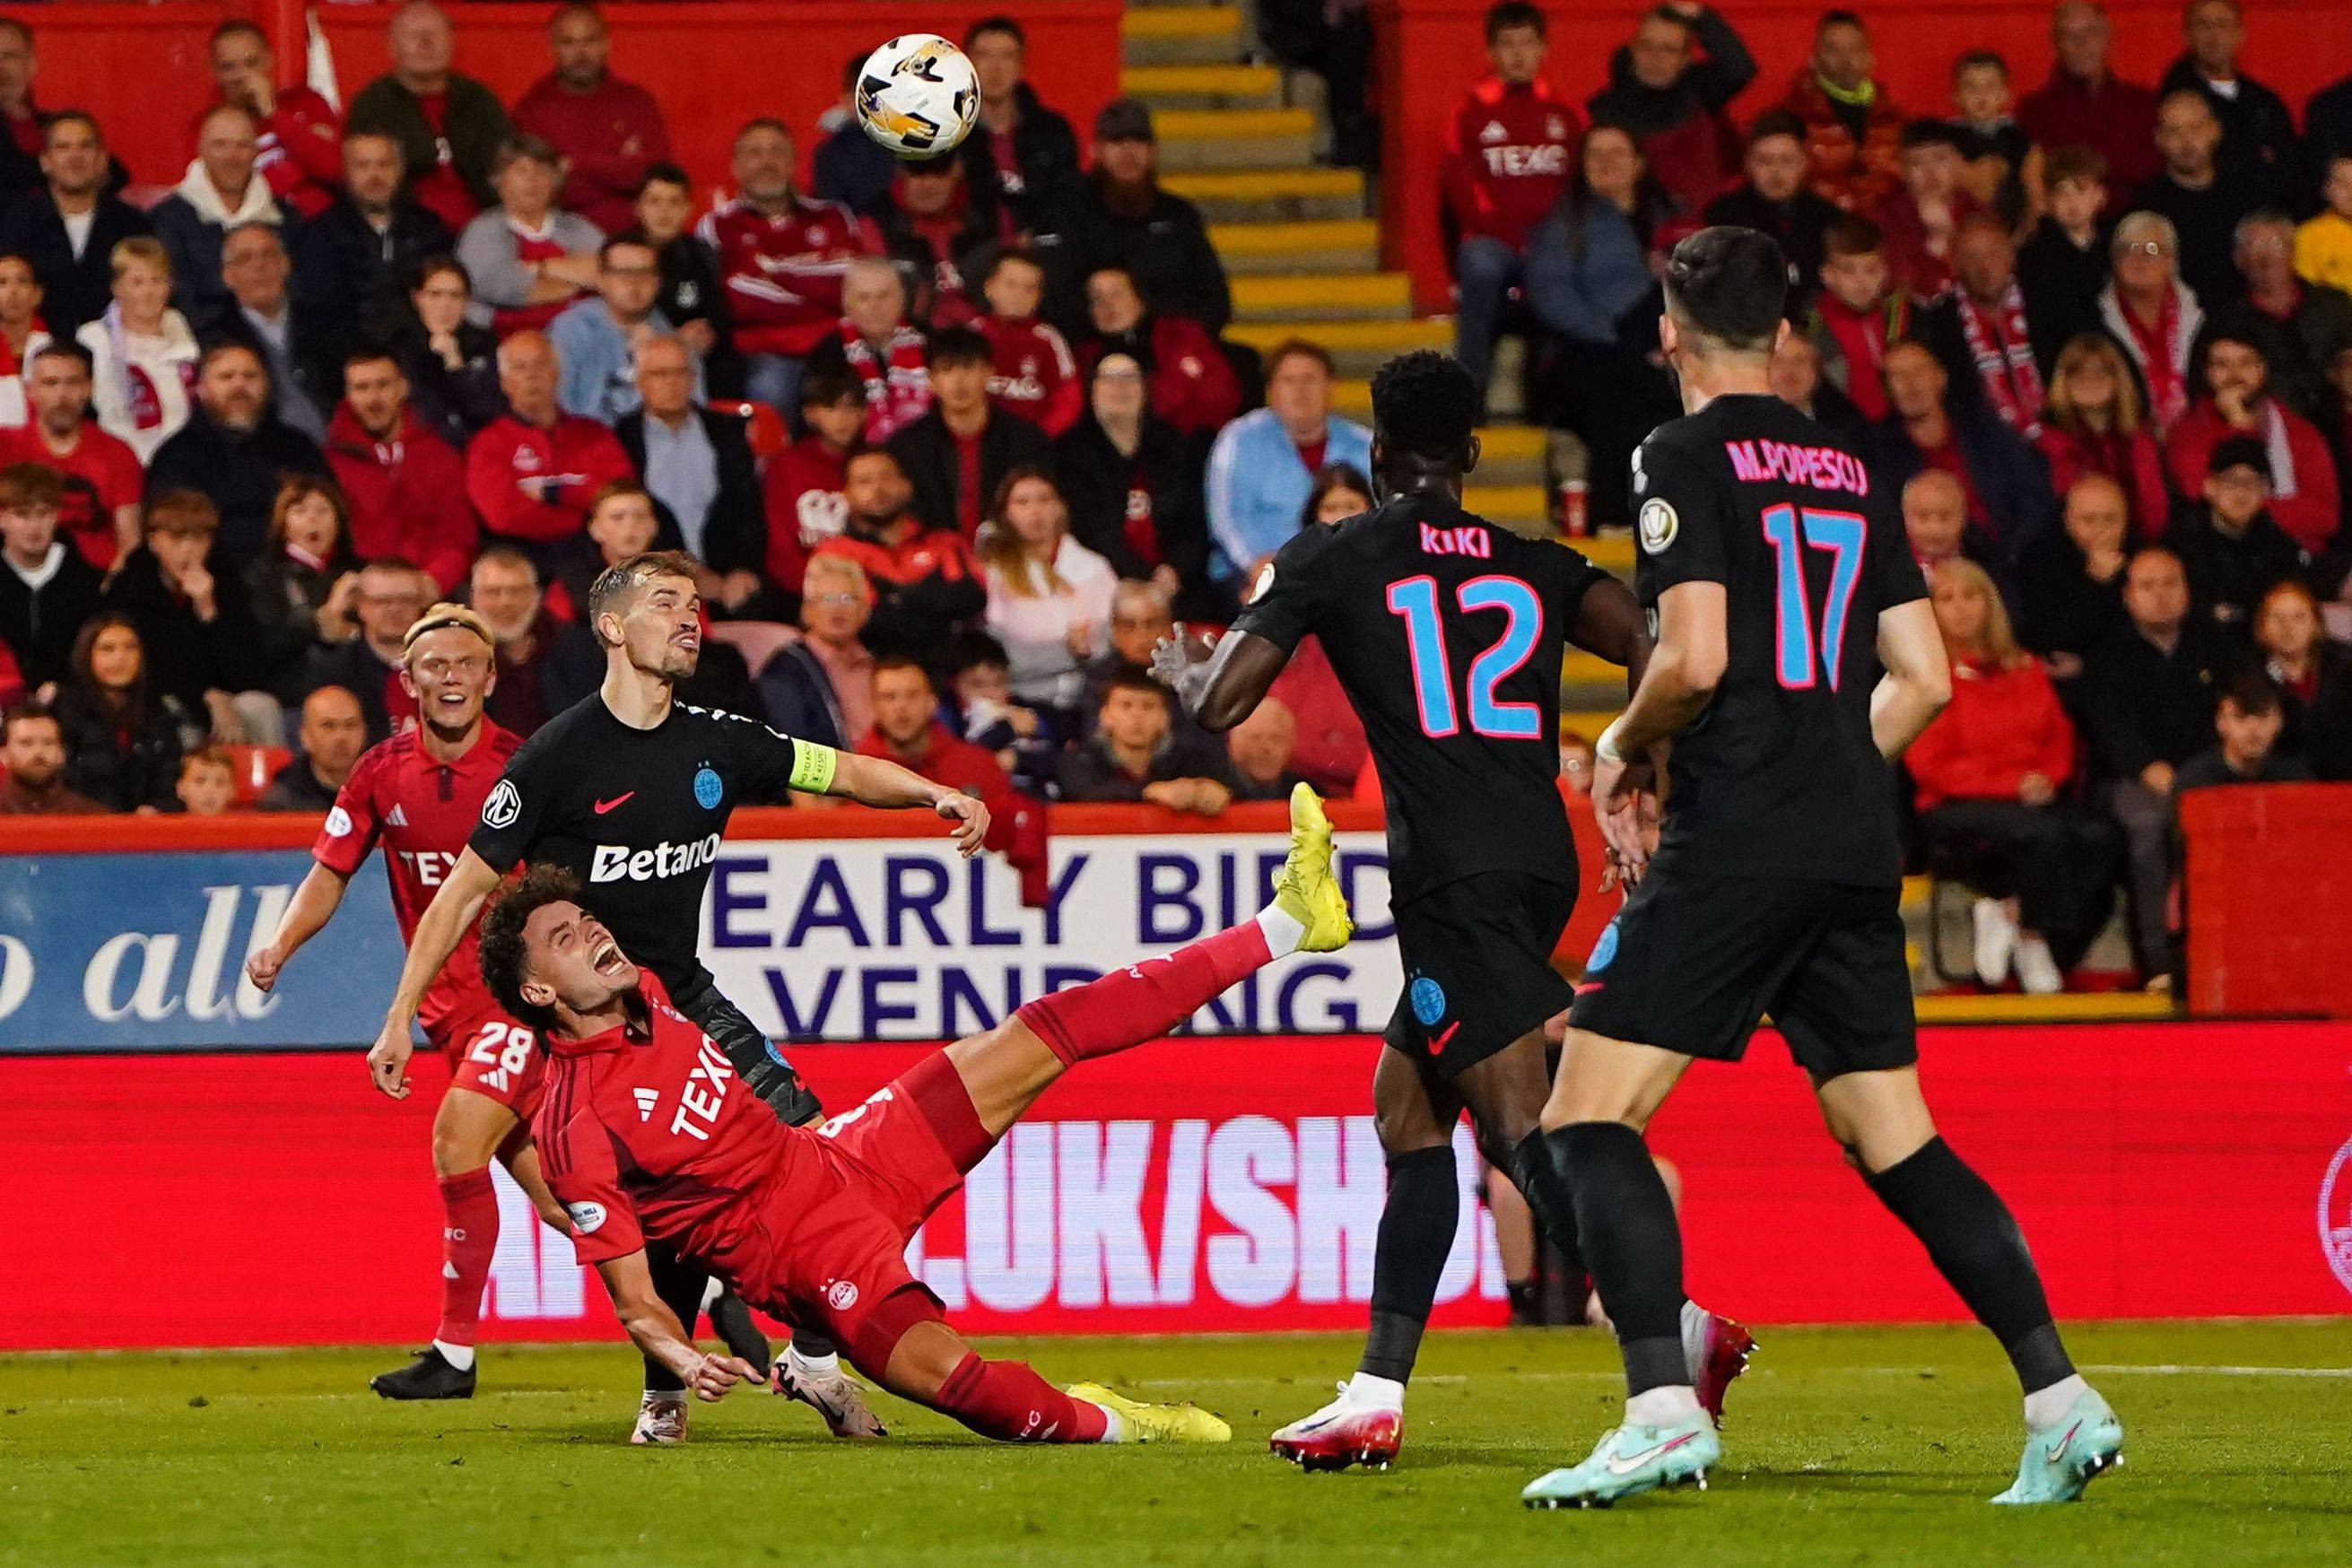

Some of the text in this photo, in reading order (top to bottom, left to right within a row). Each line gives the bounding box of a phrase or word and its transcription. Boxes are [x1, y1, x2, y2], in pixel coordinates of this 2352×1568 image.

[1419, 521, 1492, 559] KIKI
[1761, 501, 1867, 693] 17
[1386, 574, 1544, 740] 12
[483, 780, 521, 828] MG
[589, 832, 720, 883] Betano
[712, 853, 1089, 948] EARLY
[83, 884, 292, 1022] all
[470, 1021, 534, 1075] 28
